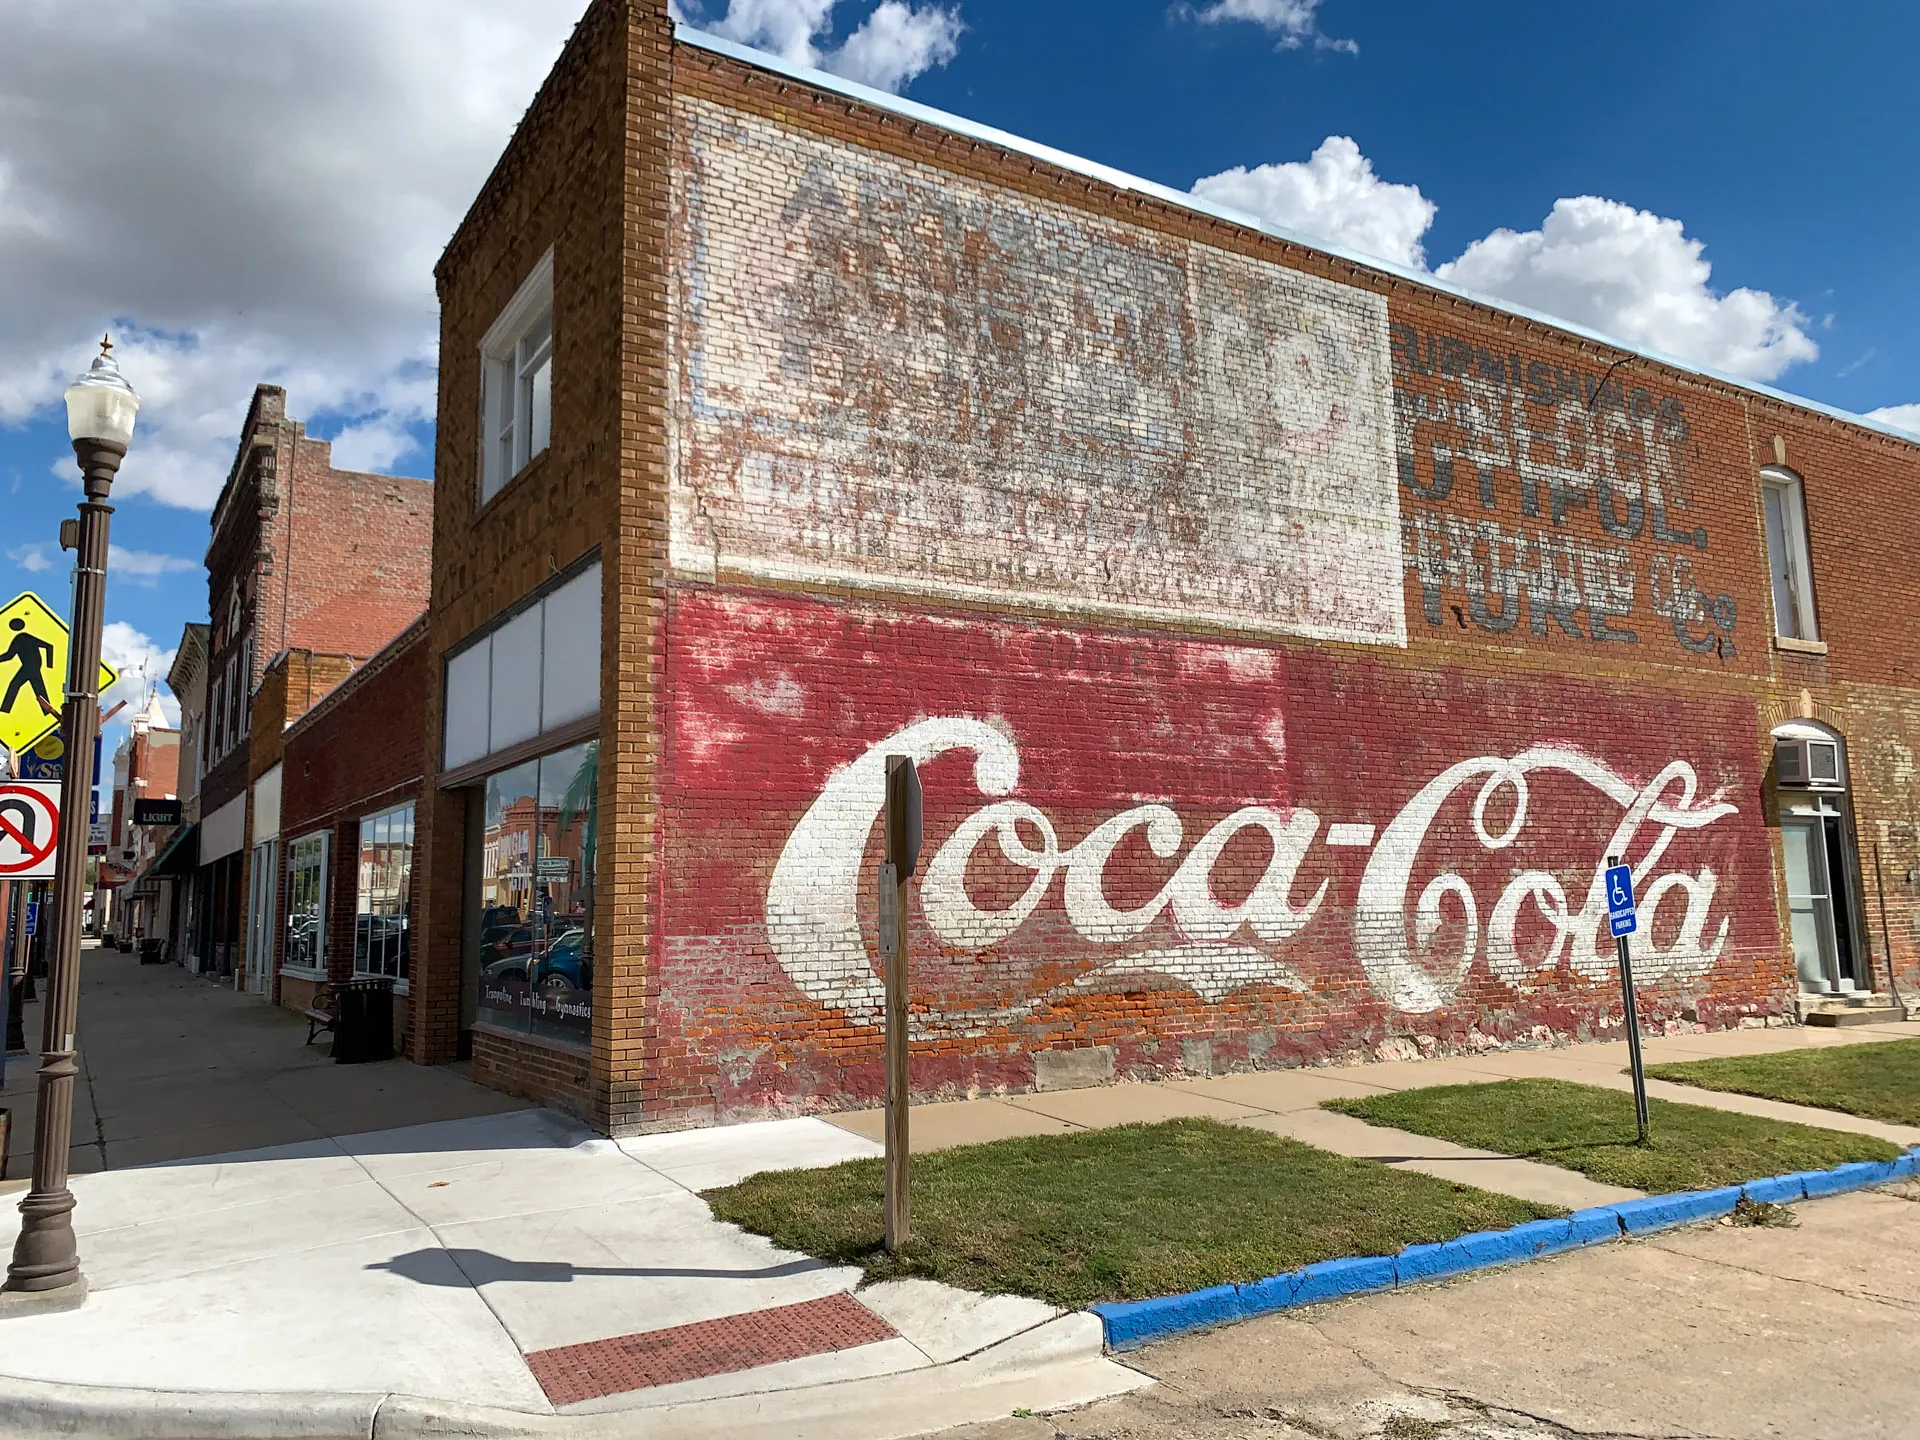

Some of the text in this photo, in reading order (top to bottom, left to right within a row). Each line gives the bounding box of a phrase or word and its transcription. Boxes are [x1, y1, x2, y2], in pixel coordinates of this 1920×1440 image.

[1609, 907, 1635, 920] HANDICAPPED
[1616, 919, 1631, 929] PARKING
[555, 995, 592, 1019] Gymnastics
